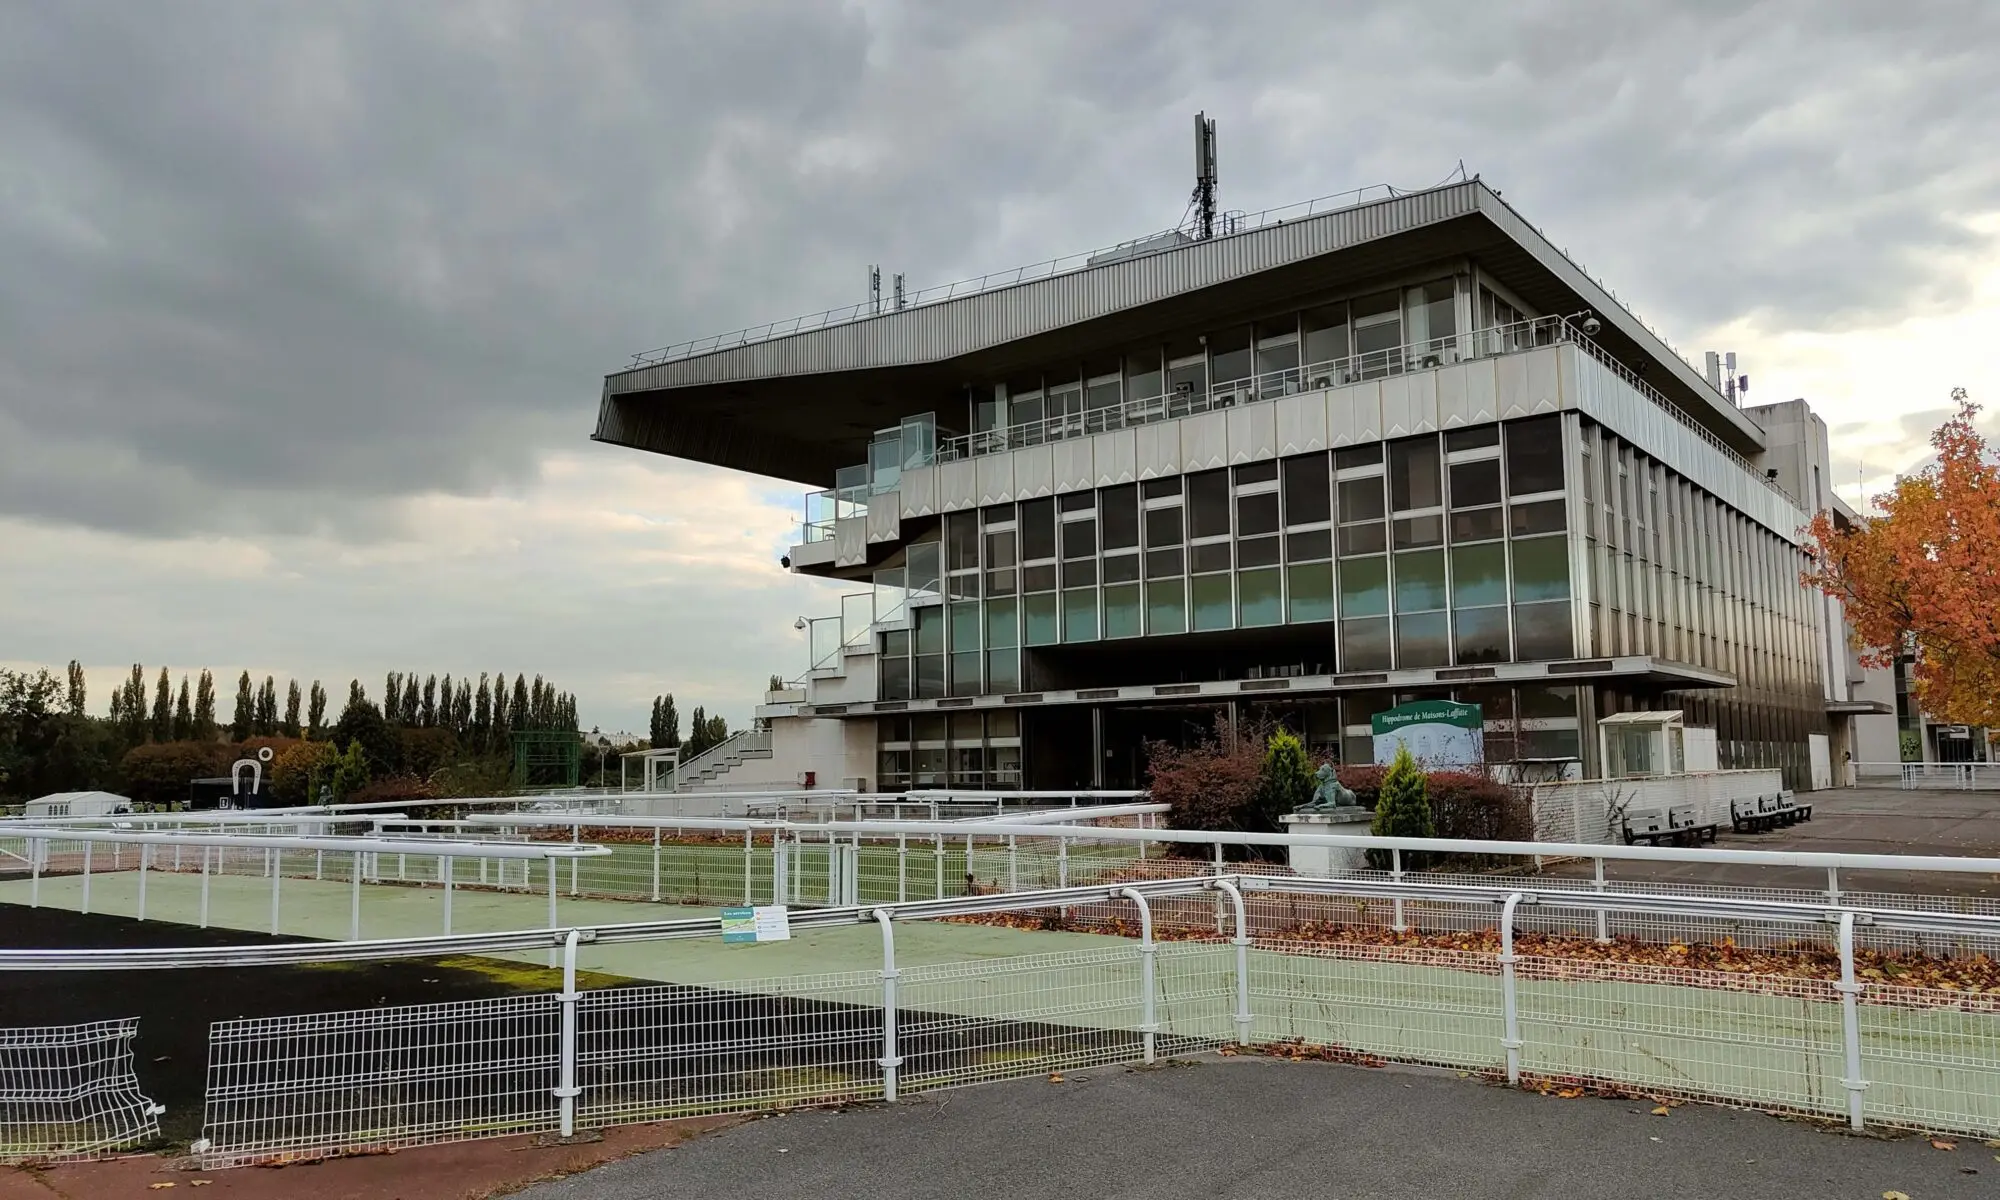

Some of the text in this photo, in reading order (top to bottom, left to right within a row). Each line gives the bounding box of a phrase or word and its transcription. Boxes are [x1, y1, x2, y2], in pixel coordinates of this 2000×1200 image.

[1382, 708, 1468, 725] Hippodrome de Maisons-Laffitte
